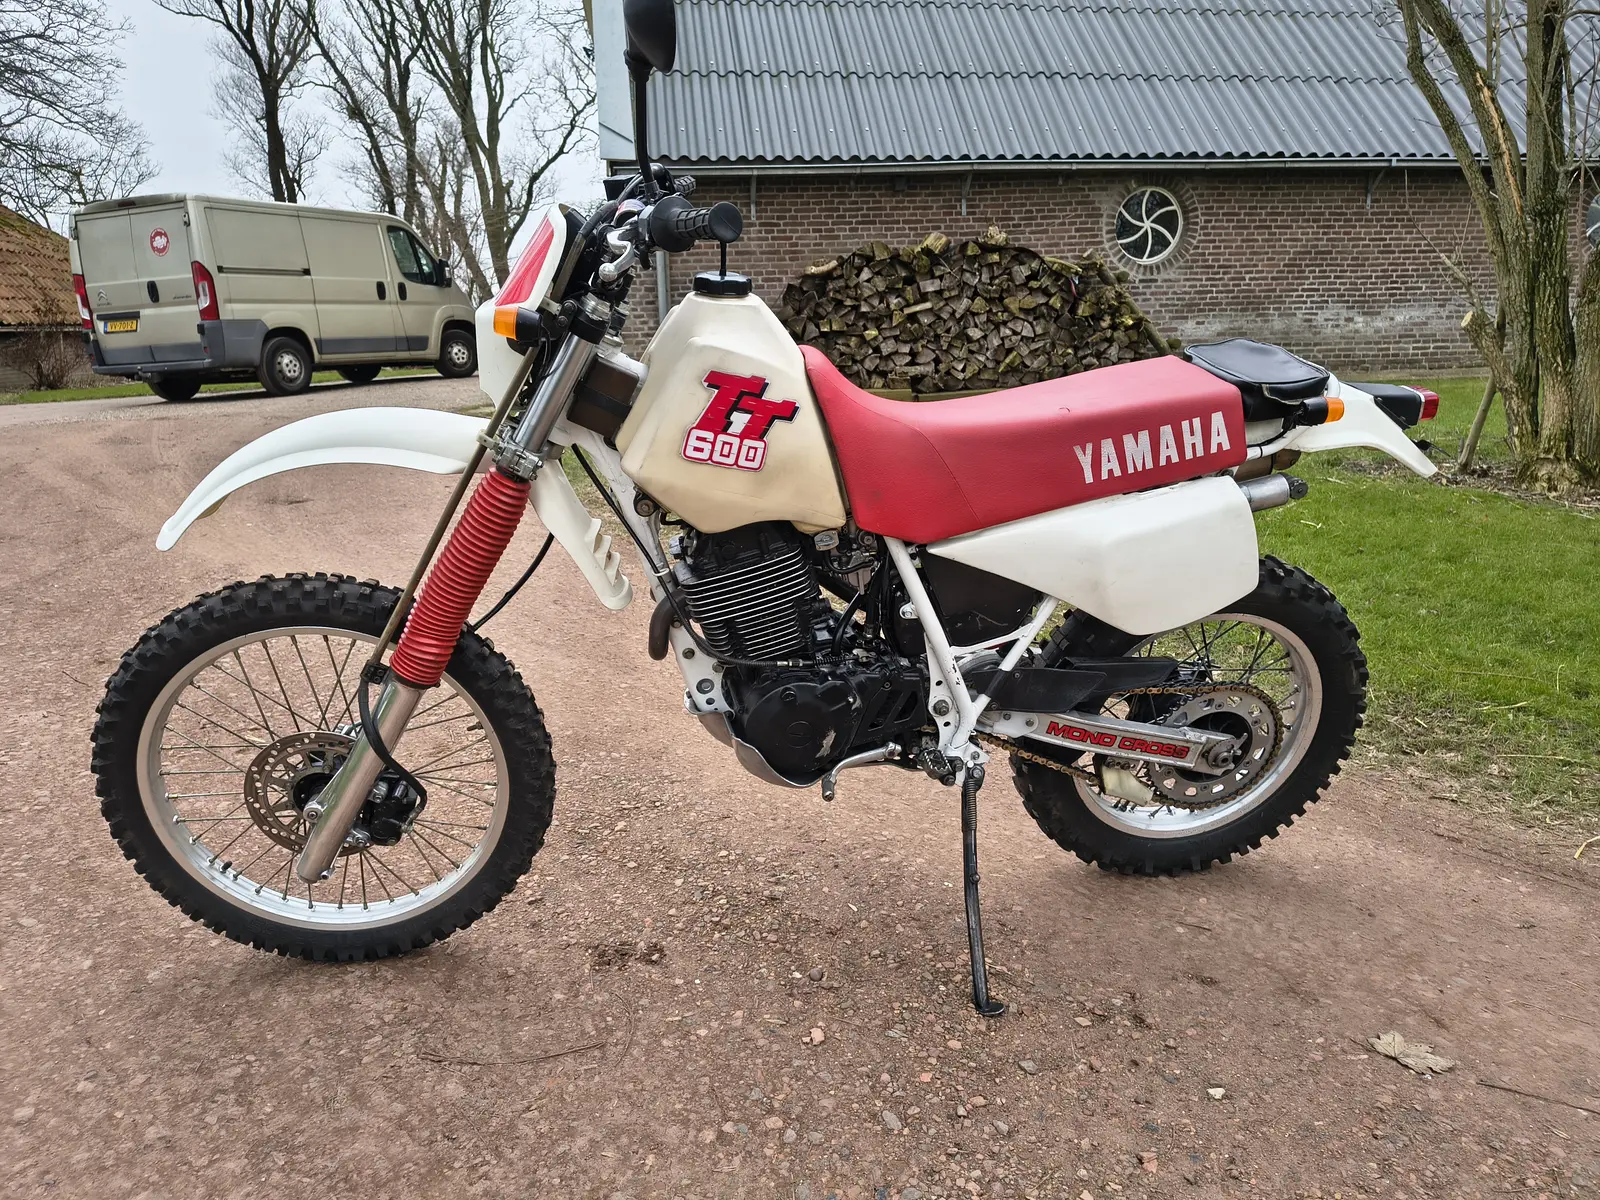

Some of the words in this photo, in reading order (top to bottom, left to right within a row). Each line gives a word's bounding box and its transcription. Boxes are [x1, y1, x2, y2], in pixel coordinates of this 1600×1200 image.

[695, 370, 800, 439] TT
[684, 428, 767, 471] 600
[1073, 411, 1231, 484] YAMAHA
[1046, 721, 1117, 747] MONO
[1118, 736, 1190, 759] CROSS
